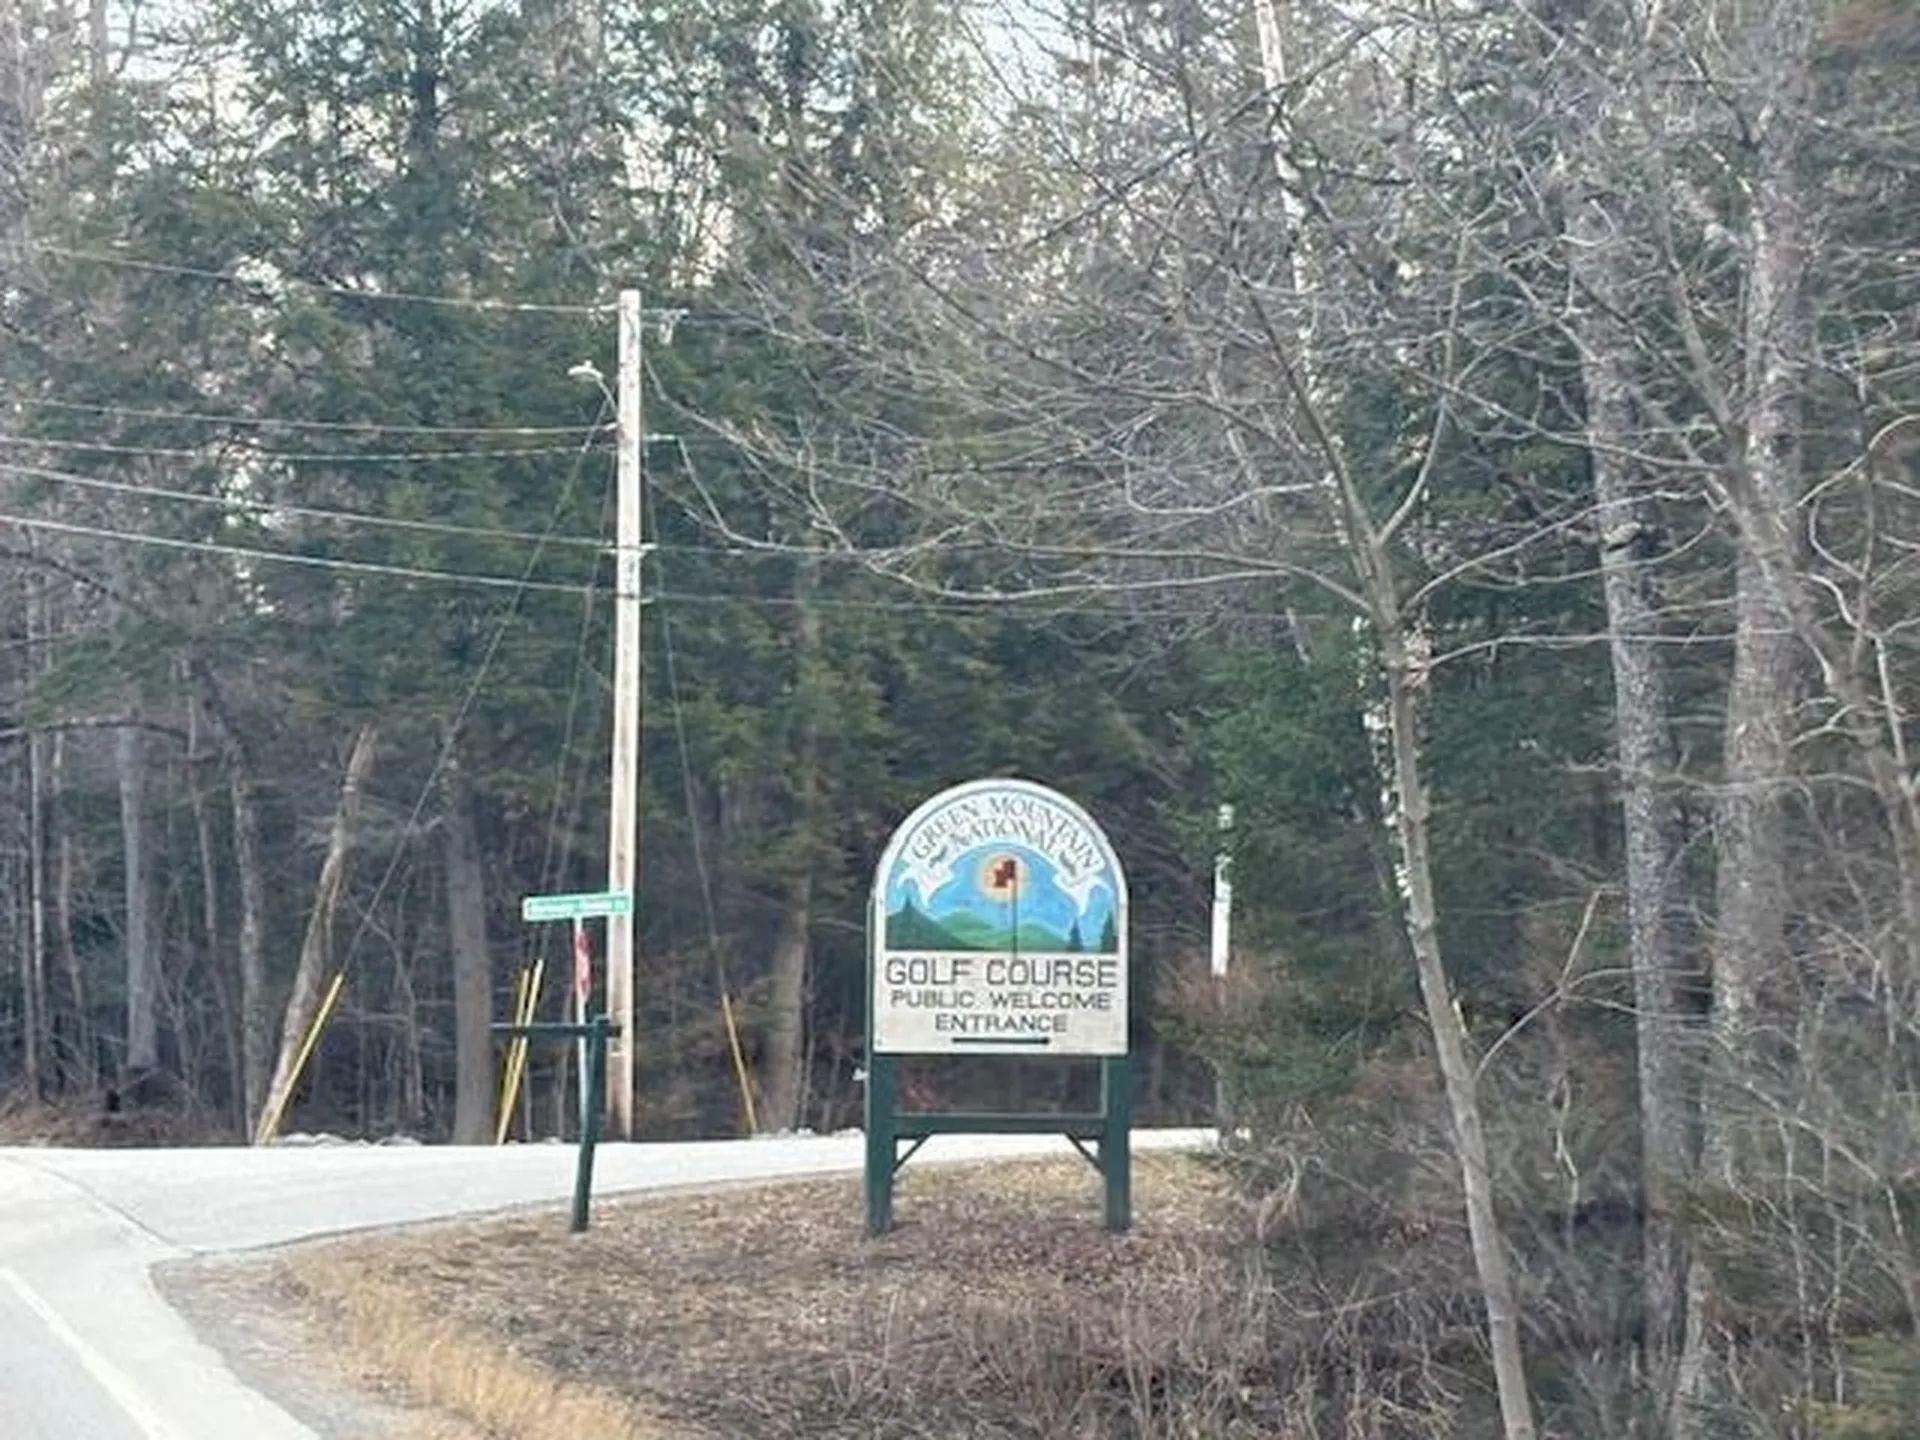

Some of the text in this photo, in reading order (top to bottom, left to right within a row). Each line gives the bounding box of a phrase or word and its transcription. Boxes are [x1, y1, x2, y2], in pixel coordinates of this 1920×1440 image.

[911, 795, 1100, 869] GREEN MOUNTAIN
[954, 818, 1061, 857] NATIONAL
[885, 958, 1118, 988] GOLF COURSE
[890, 990, 1112, 1010] PUBLIC WELCOME
[935, 1013, 1068, 1033] ENTRANCE
